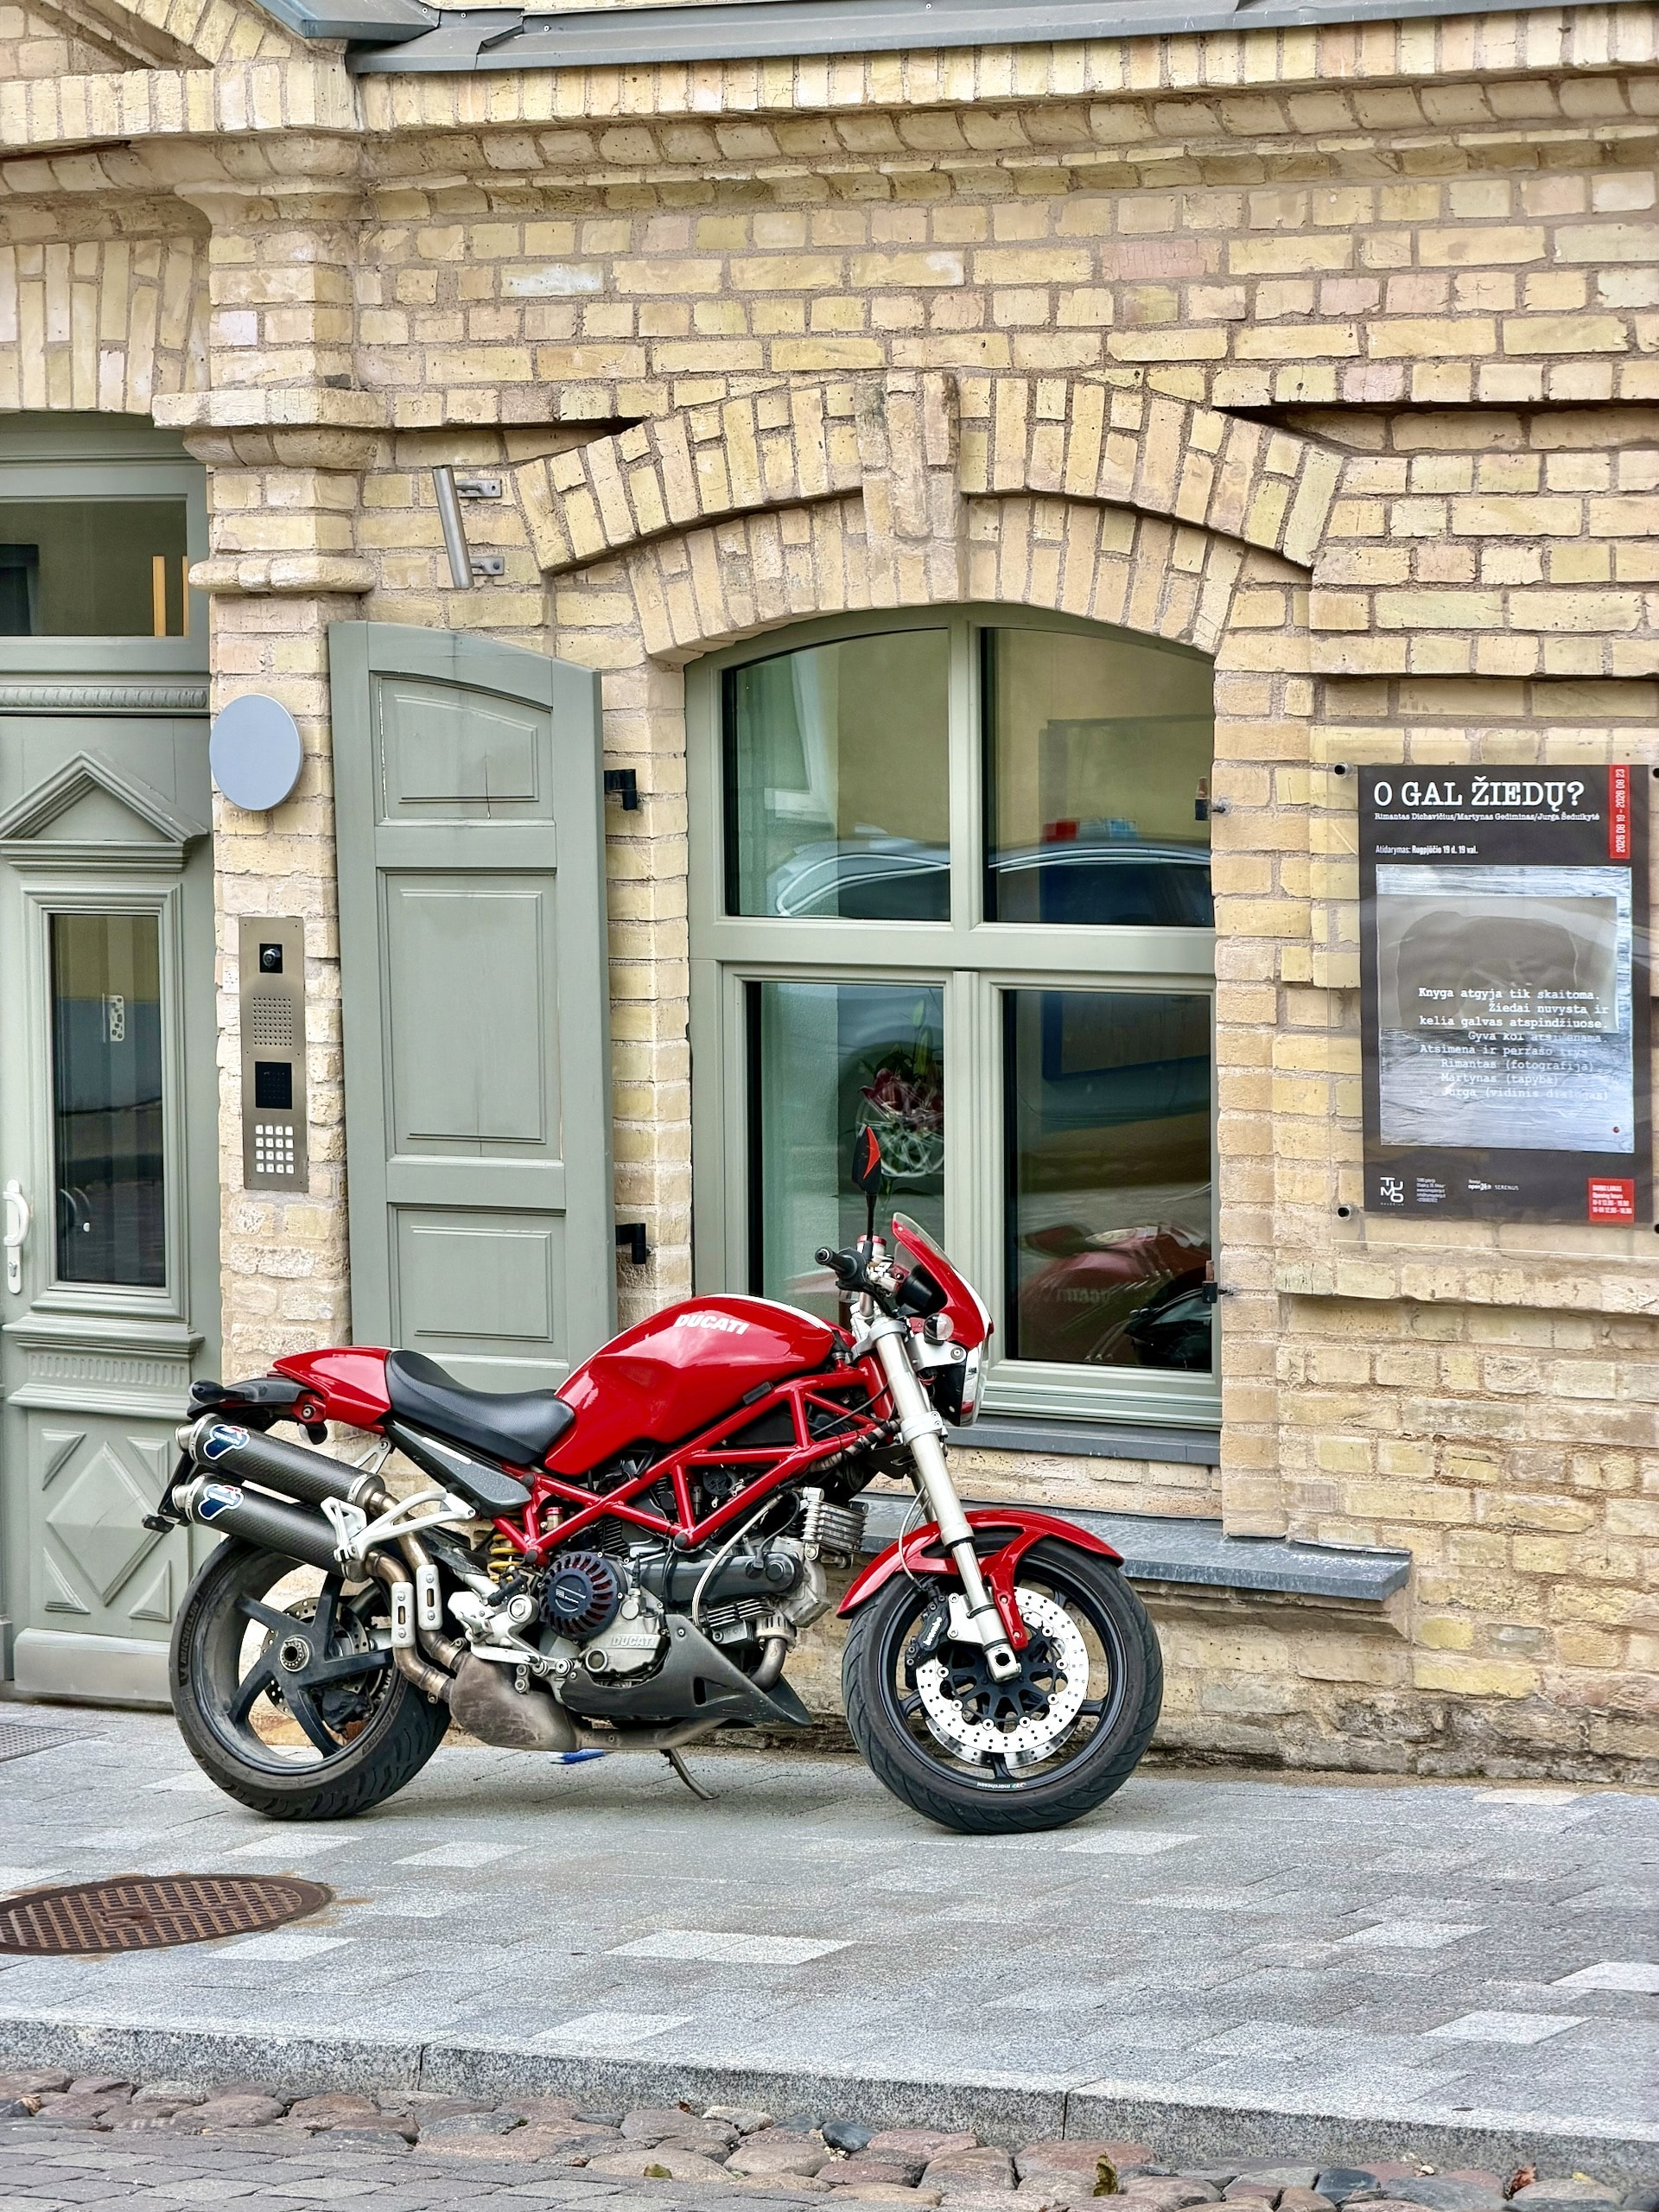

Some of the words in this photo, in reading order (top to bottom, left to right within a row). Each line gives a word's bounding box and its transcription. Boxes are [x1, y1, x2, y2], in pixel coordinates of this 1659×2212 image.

[1374, 781, 1393, 806] O
[1401, 781, 1462, 806] GAL
[1471, 775, 1585, 812] ŽIEDŲ?
[1374, 812, 1410, 821] Rimantas
[1376, 844, 1411, 855] Atidarymas:
[1443, 845, 1451, 854] 19
[1452, 845, 1458, 854] d.
[1459, 845, 1466, 854] 19
[1466, 845, 1478, 854] val.
[1418, 988, 1454, 1000] Knyga
[1460, 988, 1503, 1001] atgyja
[1510, 989, 1531, 999] tik
[1537, 989, 1600, 1000] skaitoma.
[1489, 1001, 1531, 1012] Žiedai
[1537, 1003, 1588, 1015] nuvysta
[1594, 1005, 1610, 1014] ir
[1419, 1015, 1455, 1026] kelia
[1460, 1016, 1503, 1028] galvas
[1510, 1018, 1608, 1029] atspindžiuose.
[1467, 1031, 1497, 1042] Gyva
[1420, 1044, 1476, 1054] Atsimena
[1483, 1045, 1497, 1054] ir
[1441, 1058, 1497, 1069] Rimantas
[1506, 1059, 1593, 1071] (fotografija)
[1440, 1072, 1497, 1084] Martynas
[1506, 1073, 1558, 1086] (tapyba)
[1485, 1088, 1538, 1099] (vidinis
[672, 1314, 750, 1335] DUCATI
[179, 1600, 200, 1664] MICHELIN
[923, 1617, 942, 1645] brembo
[612, 1635, 655, 1647] DUCATI
